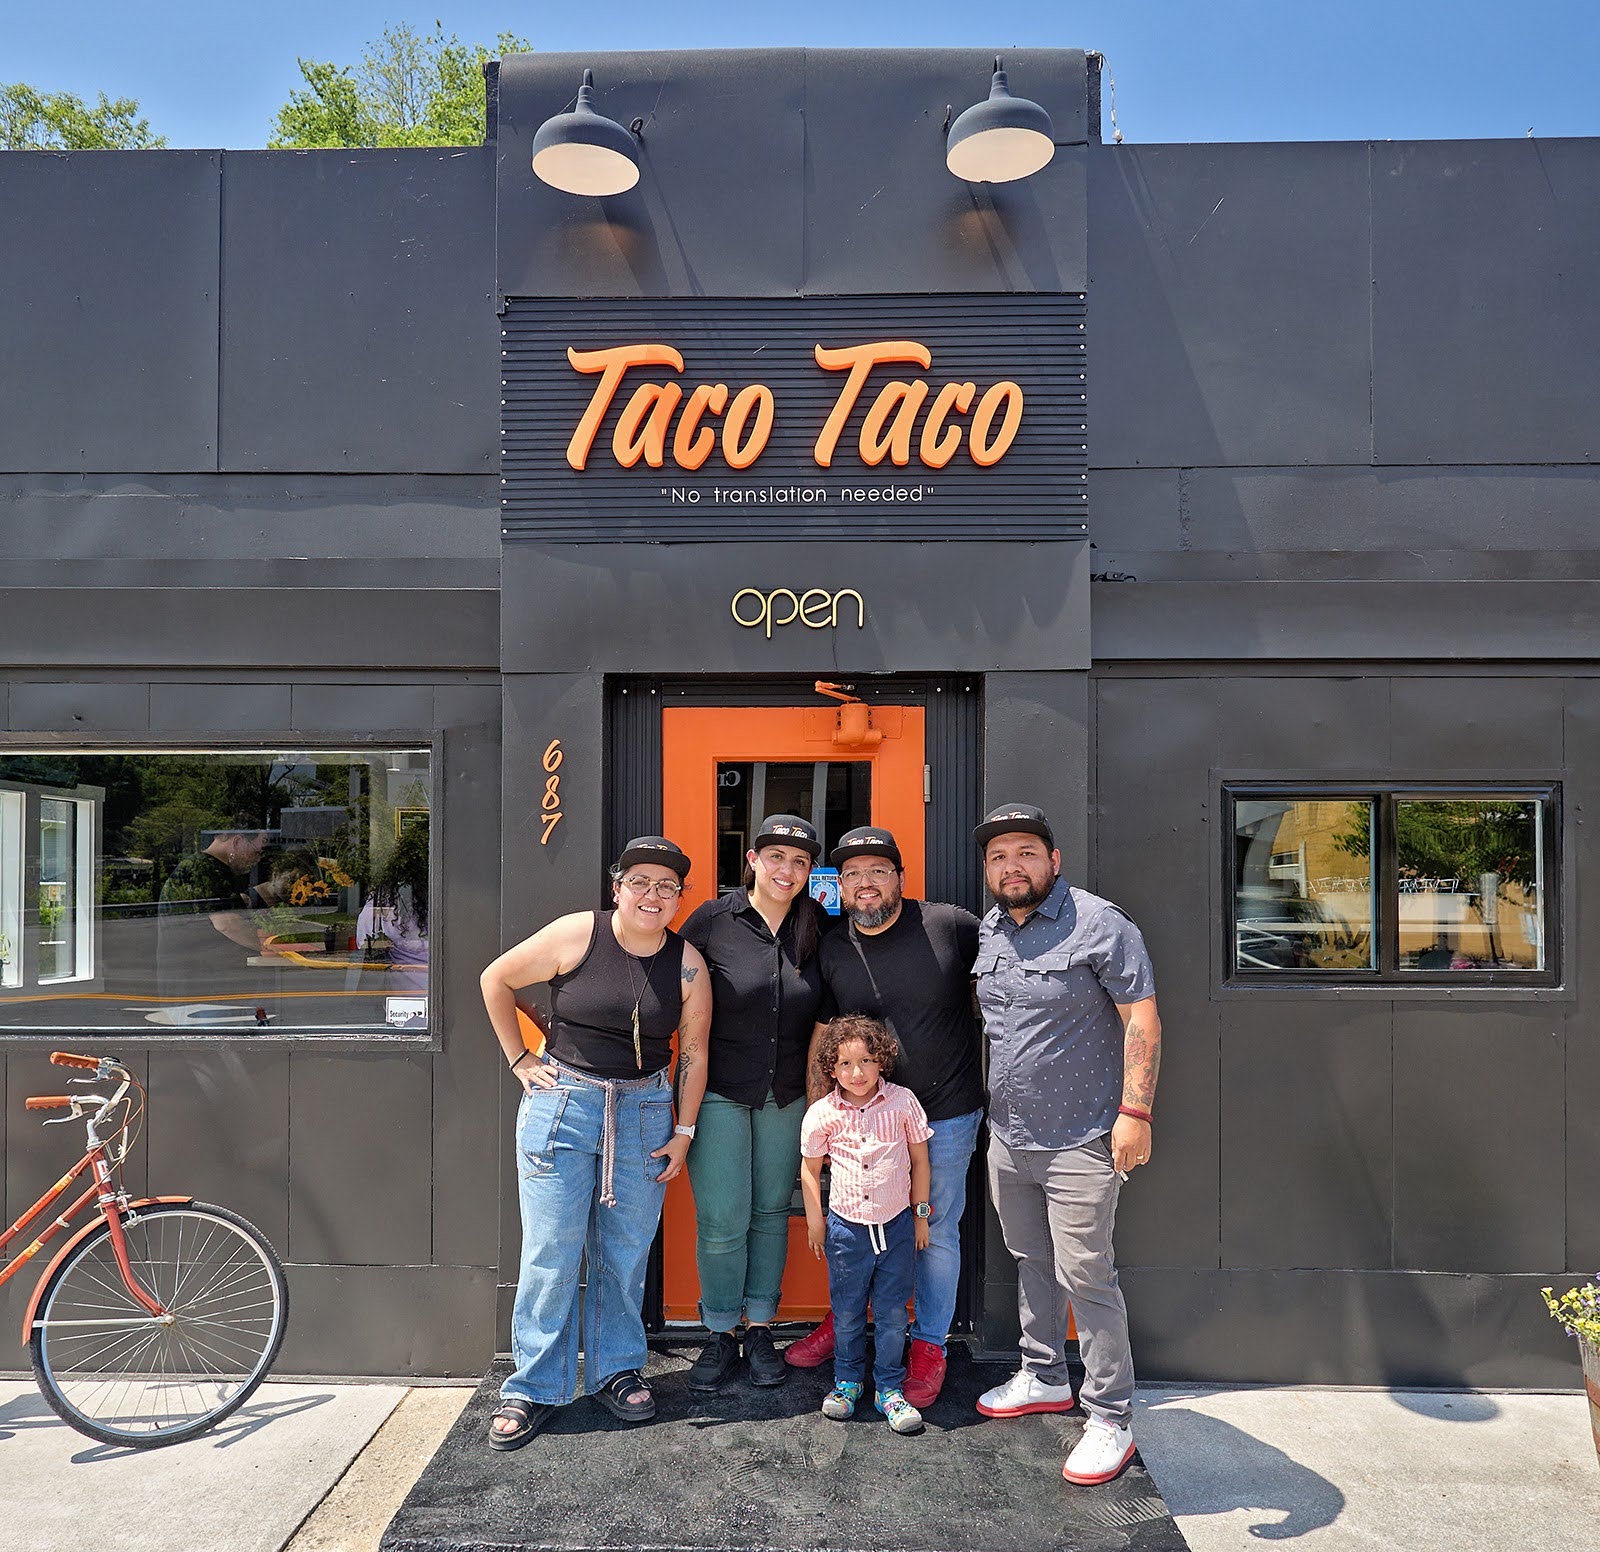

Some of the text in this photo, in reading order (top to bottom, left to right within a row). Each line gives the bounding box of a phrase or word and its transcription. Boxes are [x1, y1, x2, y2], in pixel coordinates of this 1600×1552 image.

[566, 340, 1024, 471] Taco Taco
[660, 484, 935, 504] "No translation needed"
[731, 587, 864, 638] open
[541, 739, 563, 845] 687
[772, 824, 808, 839] Taco Taco
[390, 1010, 409, 1019] Security
